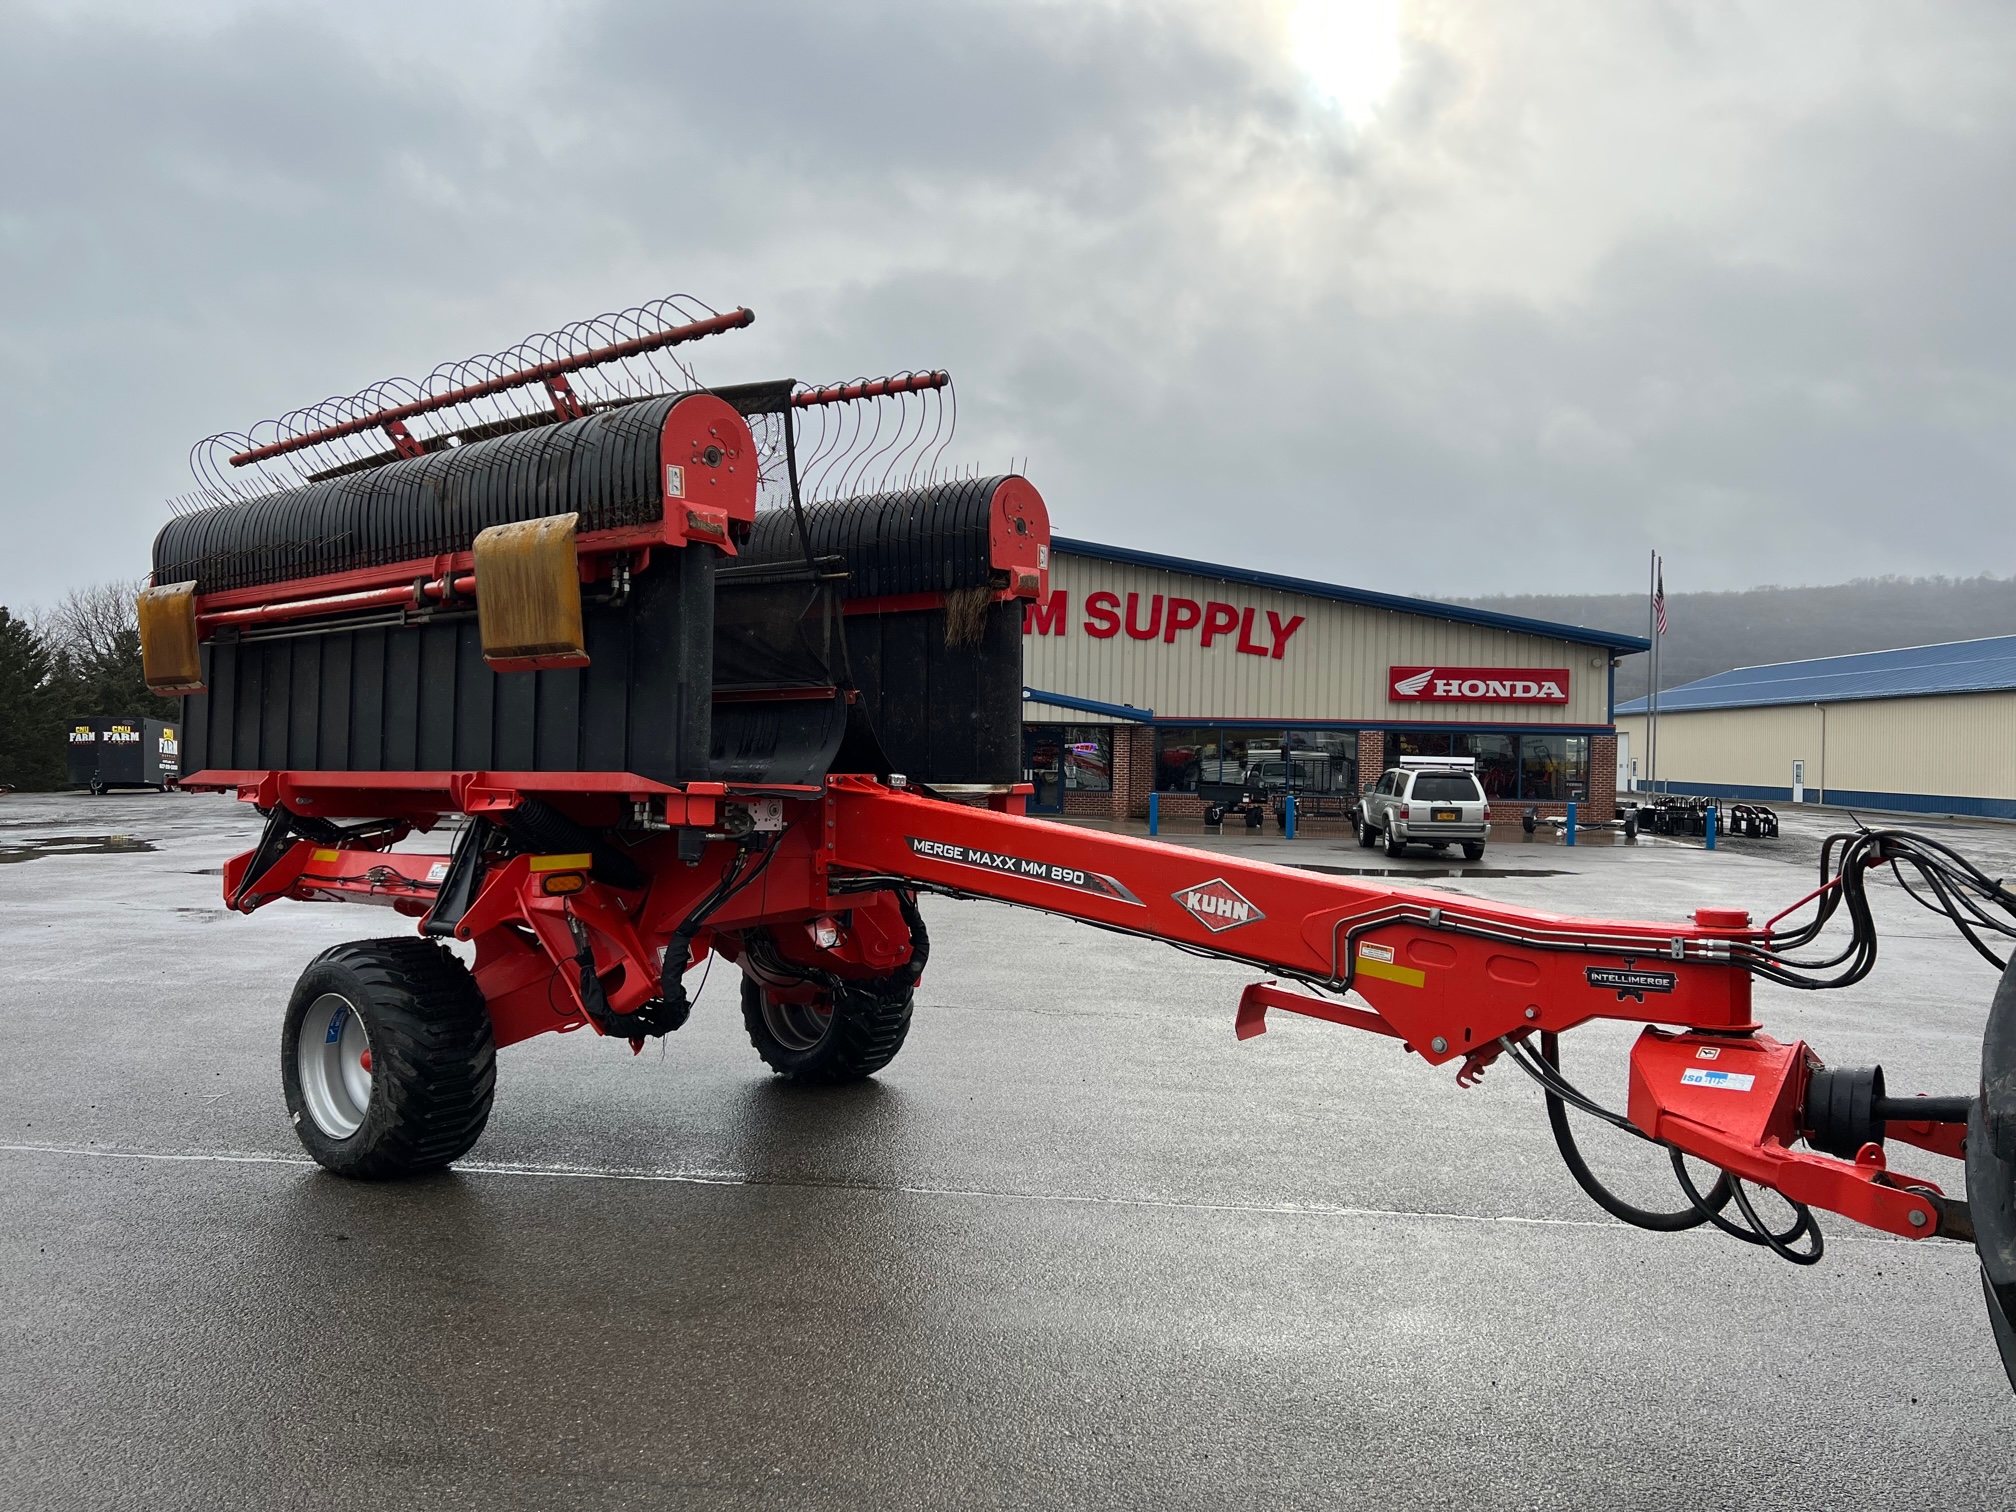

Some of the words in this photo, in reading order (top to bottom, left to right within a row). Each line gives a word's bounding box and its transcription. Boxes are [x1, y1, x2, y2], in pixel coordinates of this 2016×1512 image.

[1084, 591, 1306, 660] SUPPLY
[1433, 679, 1566, 698] HONDA
[69, 731, 96, 742] FARM
[103, 731, 140, 742] FARM
[913, 838, 964, 860] MERGE
[968, 849, 1017, 871] MAXX
[1021, 860, 1047, 877] MM
[1051, 866, 1085, 885] 890
[1187, 891, 1249, 921] KUHN
[1591, 973, 1670, 986] INTELLIMERGE
